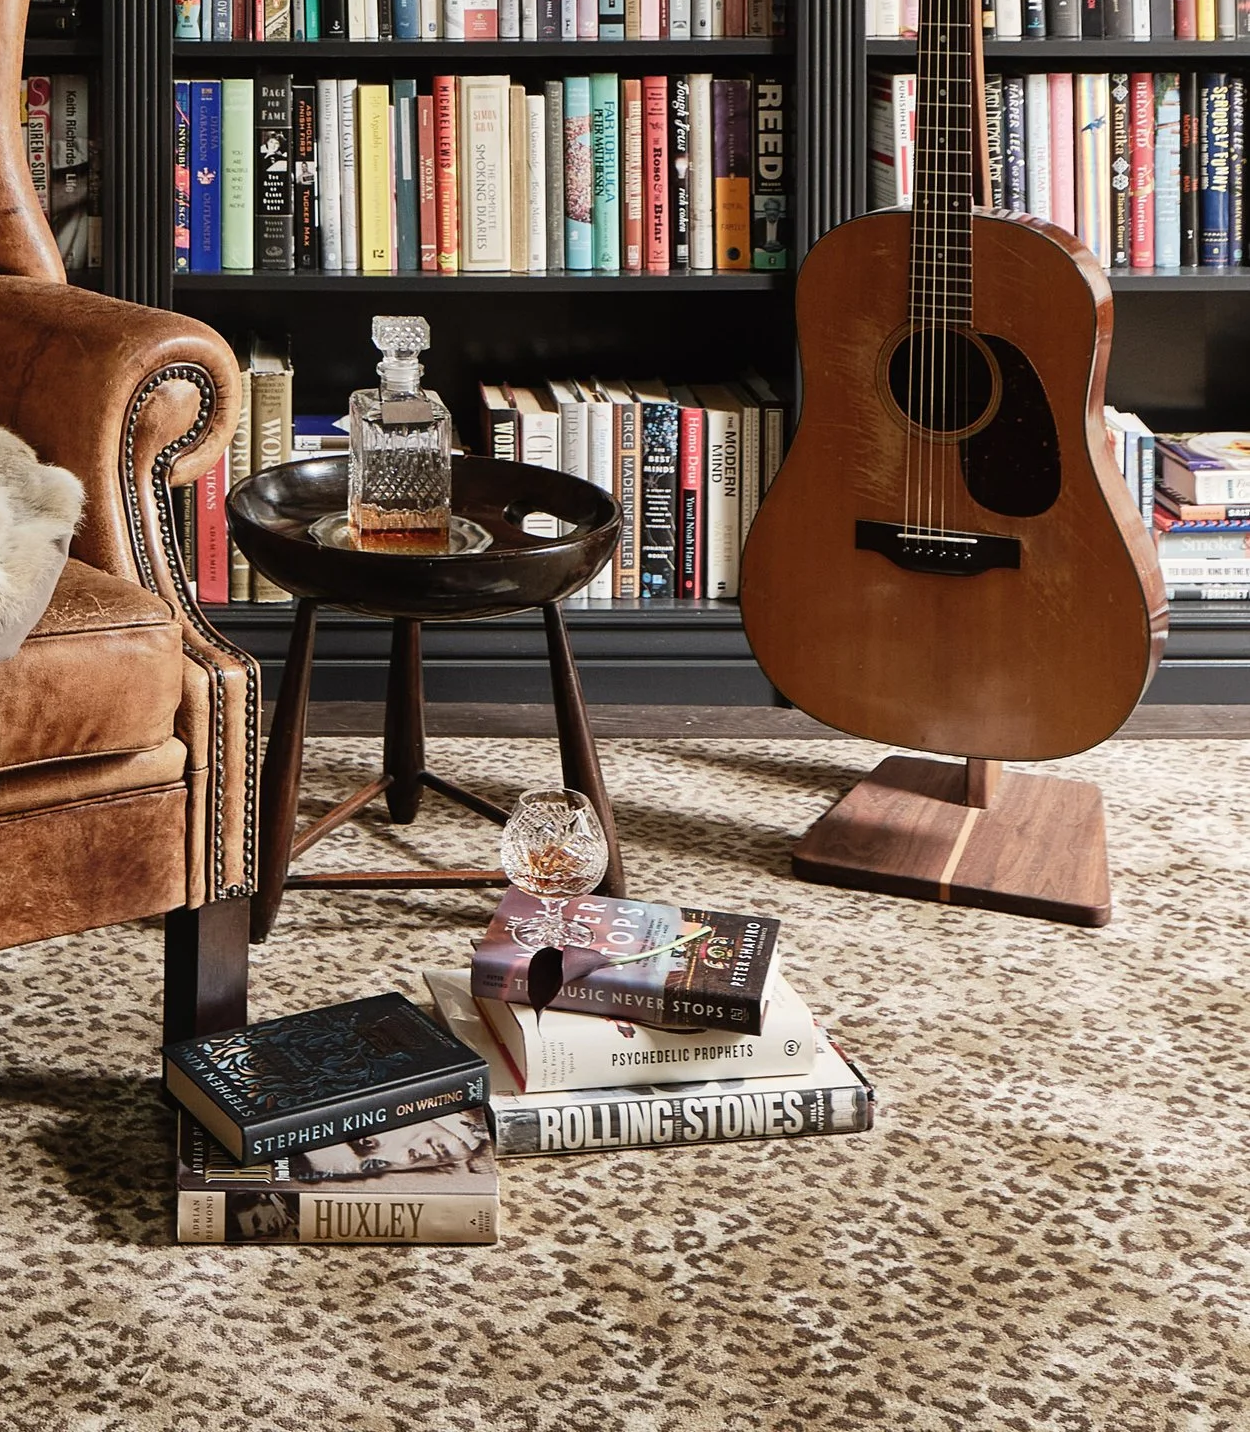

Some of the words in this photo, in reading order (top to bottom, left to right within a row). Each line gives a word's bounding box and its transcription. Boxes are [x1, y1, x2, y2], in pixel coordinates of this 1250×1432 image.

[217, 0, 227, 16] OVE
[66, 91, 76, 116] Keith
[440, 86, 449, 133] MICHAEL
[605, 101, 614, 126] FAR
[30, 123, 43, 153] SIREN
[66, 120, 76, 165] Richards
[758, 85, 782, 179] REED
[1113, 103, 1127, 154] Kantika
[440, 136, 450, 168] LEWIS
[605, 129, 615, 202] TORTUGA
[32, 163, 45, 190] SONG
[65, 174, 76, 192] Life
[475, 144, 487, 202] SMOKING
[476, 205, 487, 249] DIARIES
[623, 412, 634, 448] CIRCE
[688, 417, 700, 451] Homo
[687, 454, 698, 484] Deus
[712, 444, 723, 483] MIND
[724, 431, 737, 497] MODERN
[623, 458, 634, 522] MADELINE
[684, 497, 694, 518] Yuval
[622, 526, 634, 567] MILLER
[685, 520, 694, 543] Noah
[684, 545, 694, 573] Harari
[730, 956, 750, 988] PETER
[741, 921, 761, 959] SHAPIRO
[612, 992, 665, 1011] NEVER
[673, 1000, 724, 1018] STOPS
[611, 1048, 690, 1066] PSYCHEDELIC
[694, 1044, 753, 1060] PROPHETS
[396, 1102, 414, 1116] ON
[416, 1090, 464, 1112] WRITING
[538, 1100, 674, 1151] ROLLING
[683, 1091, 804, 1140] STONES
[816, 1089, 825, 1132] WYMAN
[254, 1121, 334, 1156] STEPHEN
[343, 1108, 388, 1133] KING
[314, 1199, 424, 1239] HUXLEY
